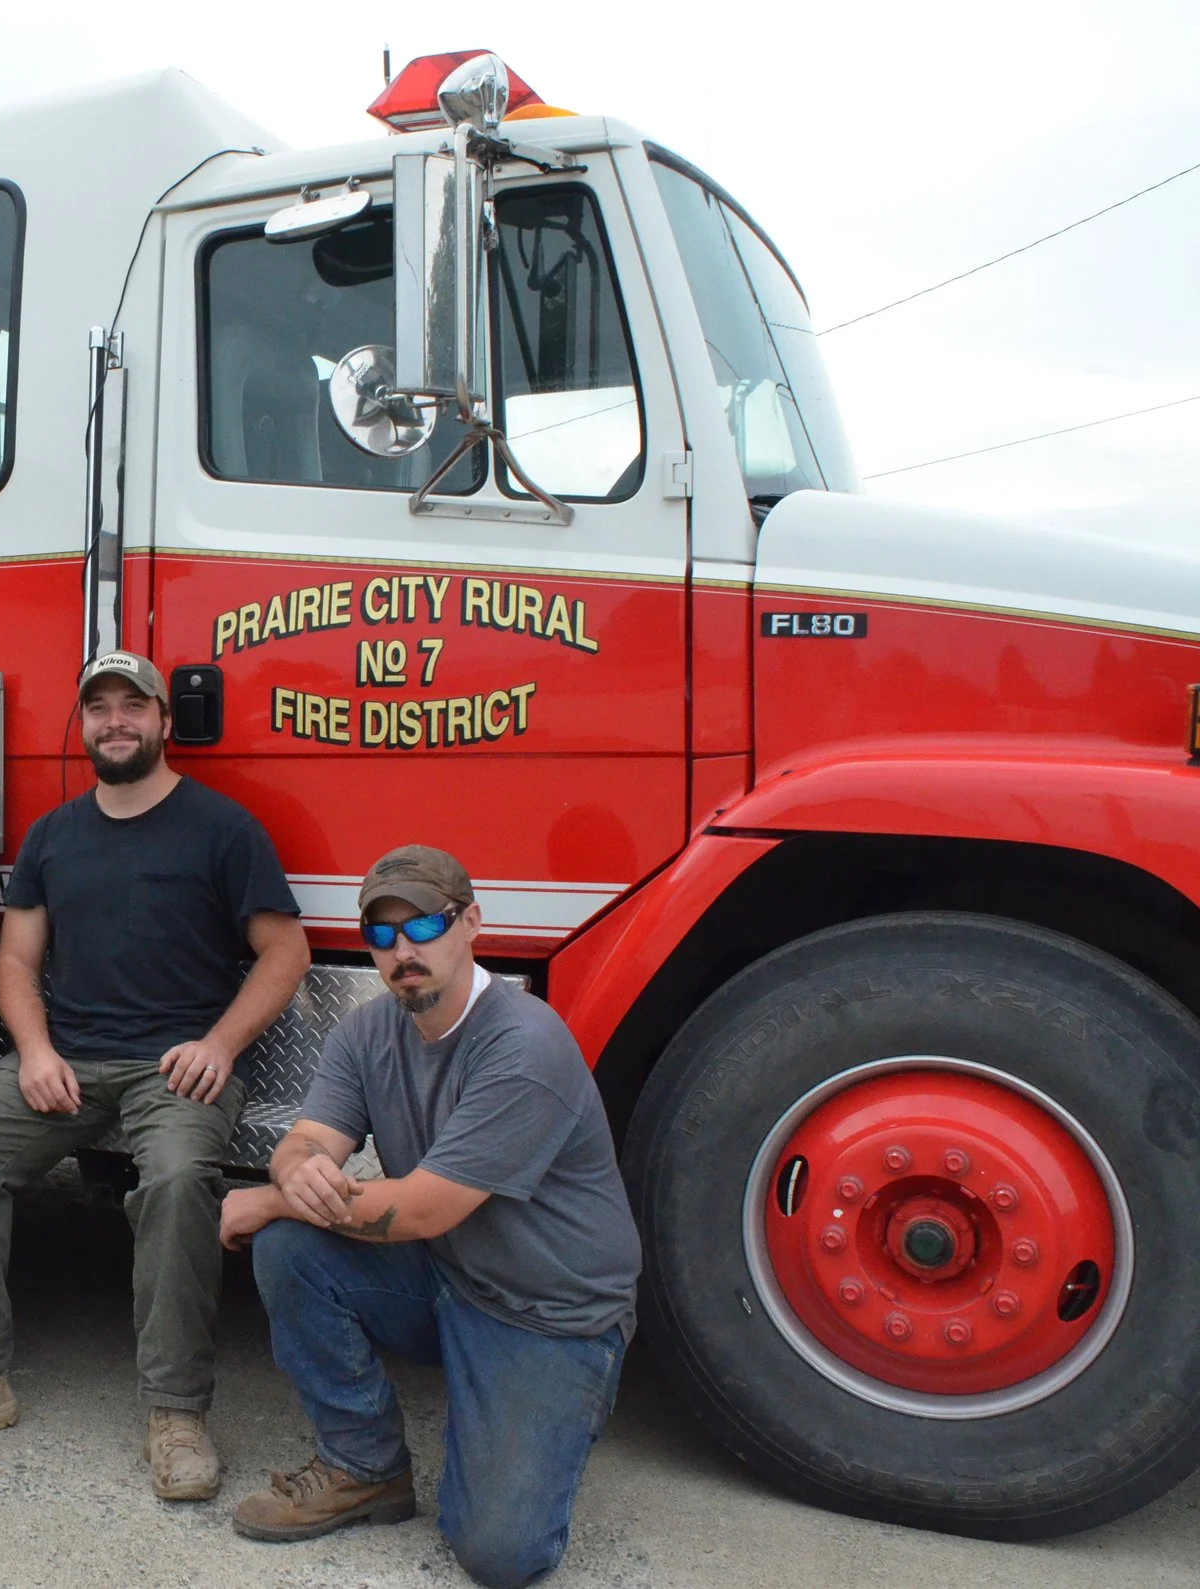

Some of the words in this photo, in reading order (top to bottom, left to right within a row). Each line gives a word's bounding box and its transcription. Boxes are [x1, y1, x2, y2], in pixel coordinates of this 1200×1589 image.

[213, 582, 353, 660] PRAIRIE
[362, 576, 451, 625] CITY
[462, 578, 599, 655] RURAL
[771, 614, 855, 635] FL80
[98, 657, 132, 668] Nikon
[418, 638, 444, 687] 7
[272, 686, 350, 744] FIRE
[361, 681, 536, 749] DISTRICT
[672, 977, 893, 1137] RADIAL
